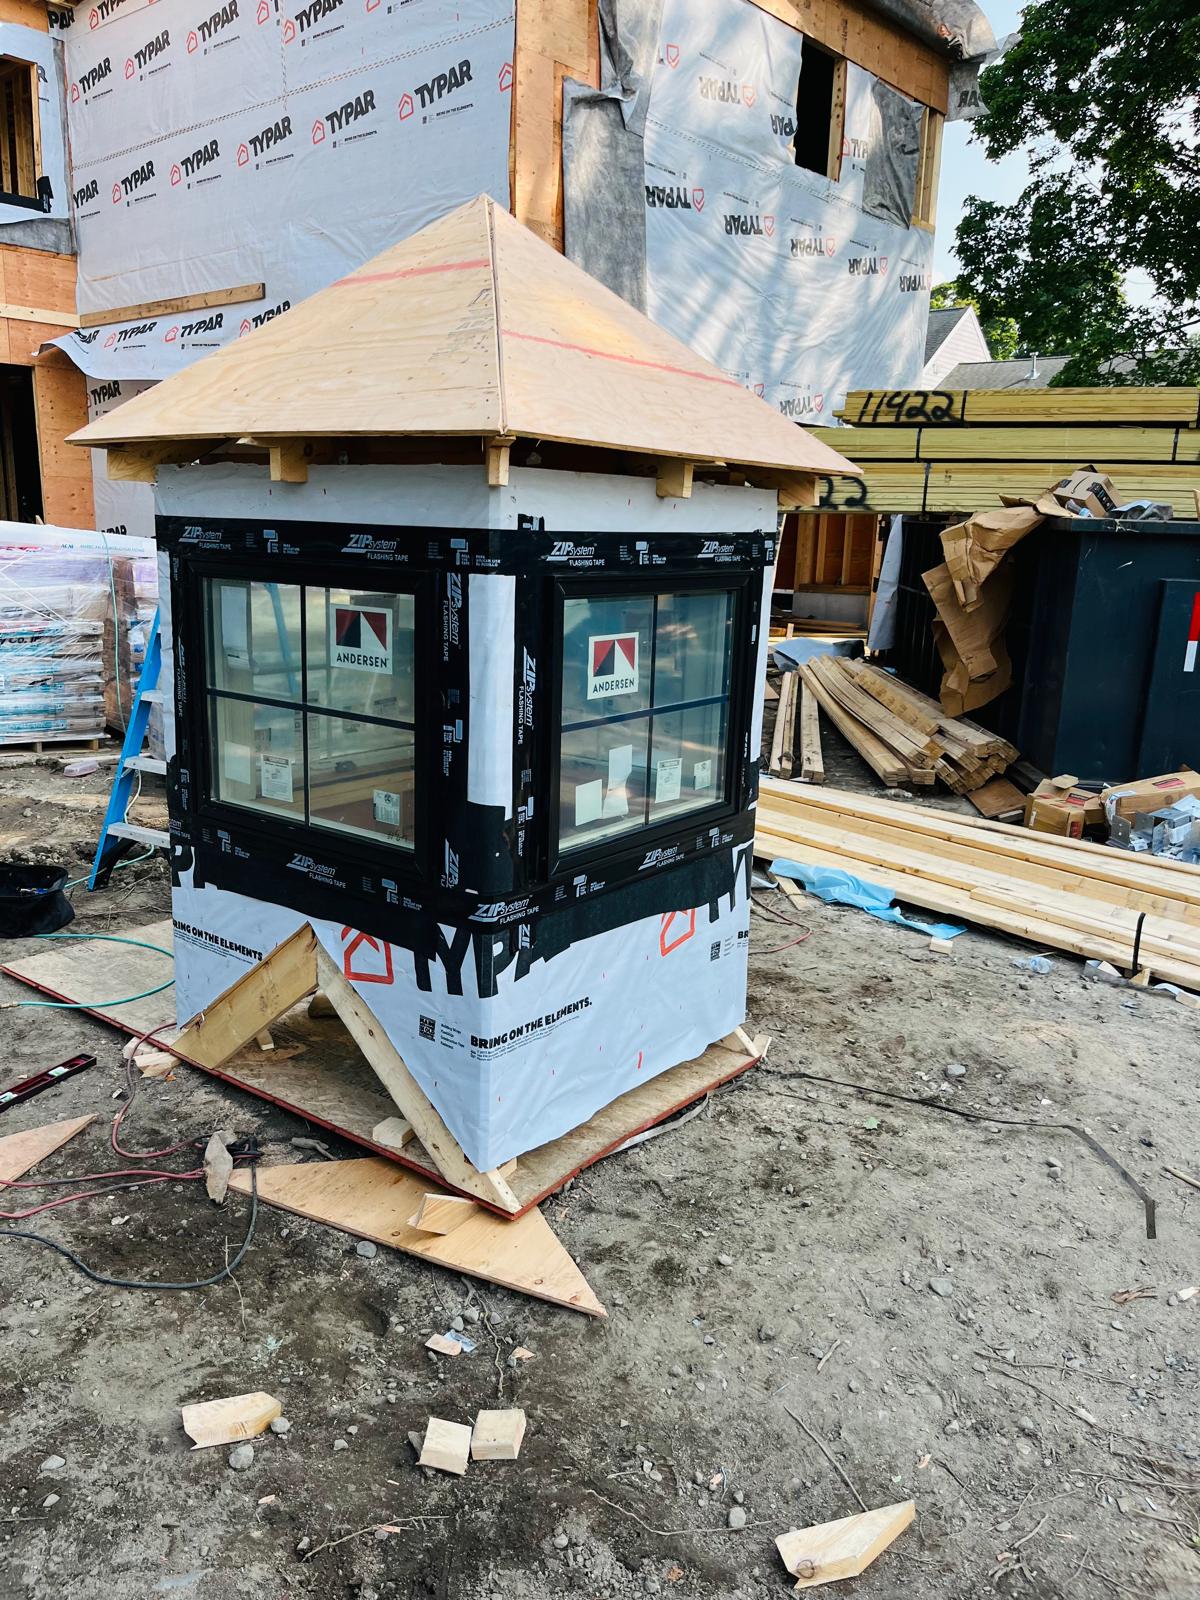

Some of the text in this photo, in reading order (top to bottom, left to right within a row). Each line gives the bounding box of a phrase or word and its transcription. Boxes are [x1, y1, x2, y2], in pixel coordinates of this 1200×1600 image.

[197, 0, 240, 42] TYPAR
[134, 29, 171, 69] TYPAR
[79, 57, 112, 94] TYPAR
[414, 59, 473, 109] TYPAR
[325, 89, 377, 134] TYPAR
[248, 115, 293, 157] TYPAR
[180, 139, 220, 177] TYPAR
[120, 160, 155, 195] TYPAR
[73, 179, 99, 209] YPAR
[645, 185, 692, 209] TYPAR
[723, 214, 763, 235] TYPAR
[790, 238, 825, 257] TYPAR
[848, 258, 880, 276] TYPAR
[118, 321, 158, 343] TYPAR
[181, 312, 224, 338] TYPAR
[90, 380, 122, 406] TYPAR
[367, 552, 394, 561] FLASHING
[336, 652, 388, 668] ANDERSEN
[592, 677, 635, 694] ANDERSEN
[499, 906, 540, 924] FLASHING TAPE
[192, 926, 203, 939] ON
[204, 931, 219, 945] THE
[220, 938, 262, 961] ELEMENTS
[470, 1032, 508, 1050] BRING
[509, 1027, 523, 1043] ON
[525, 1018, 543, 1034] THE
[545, 996, 593, 1026] ELEMENTS.
